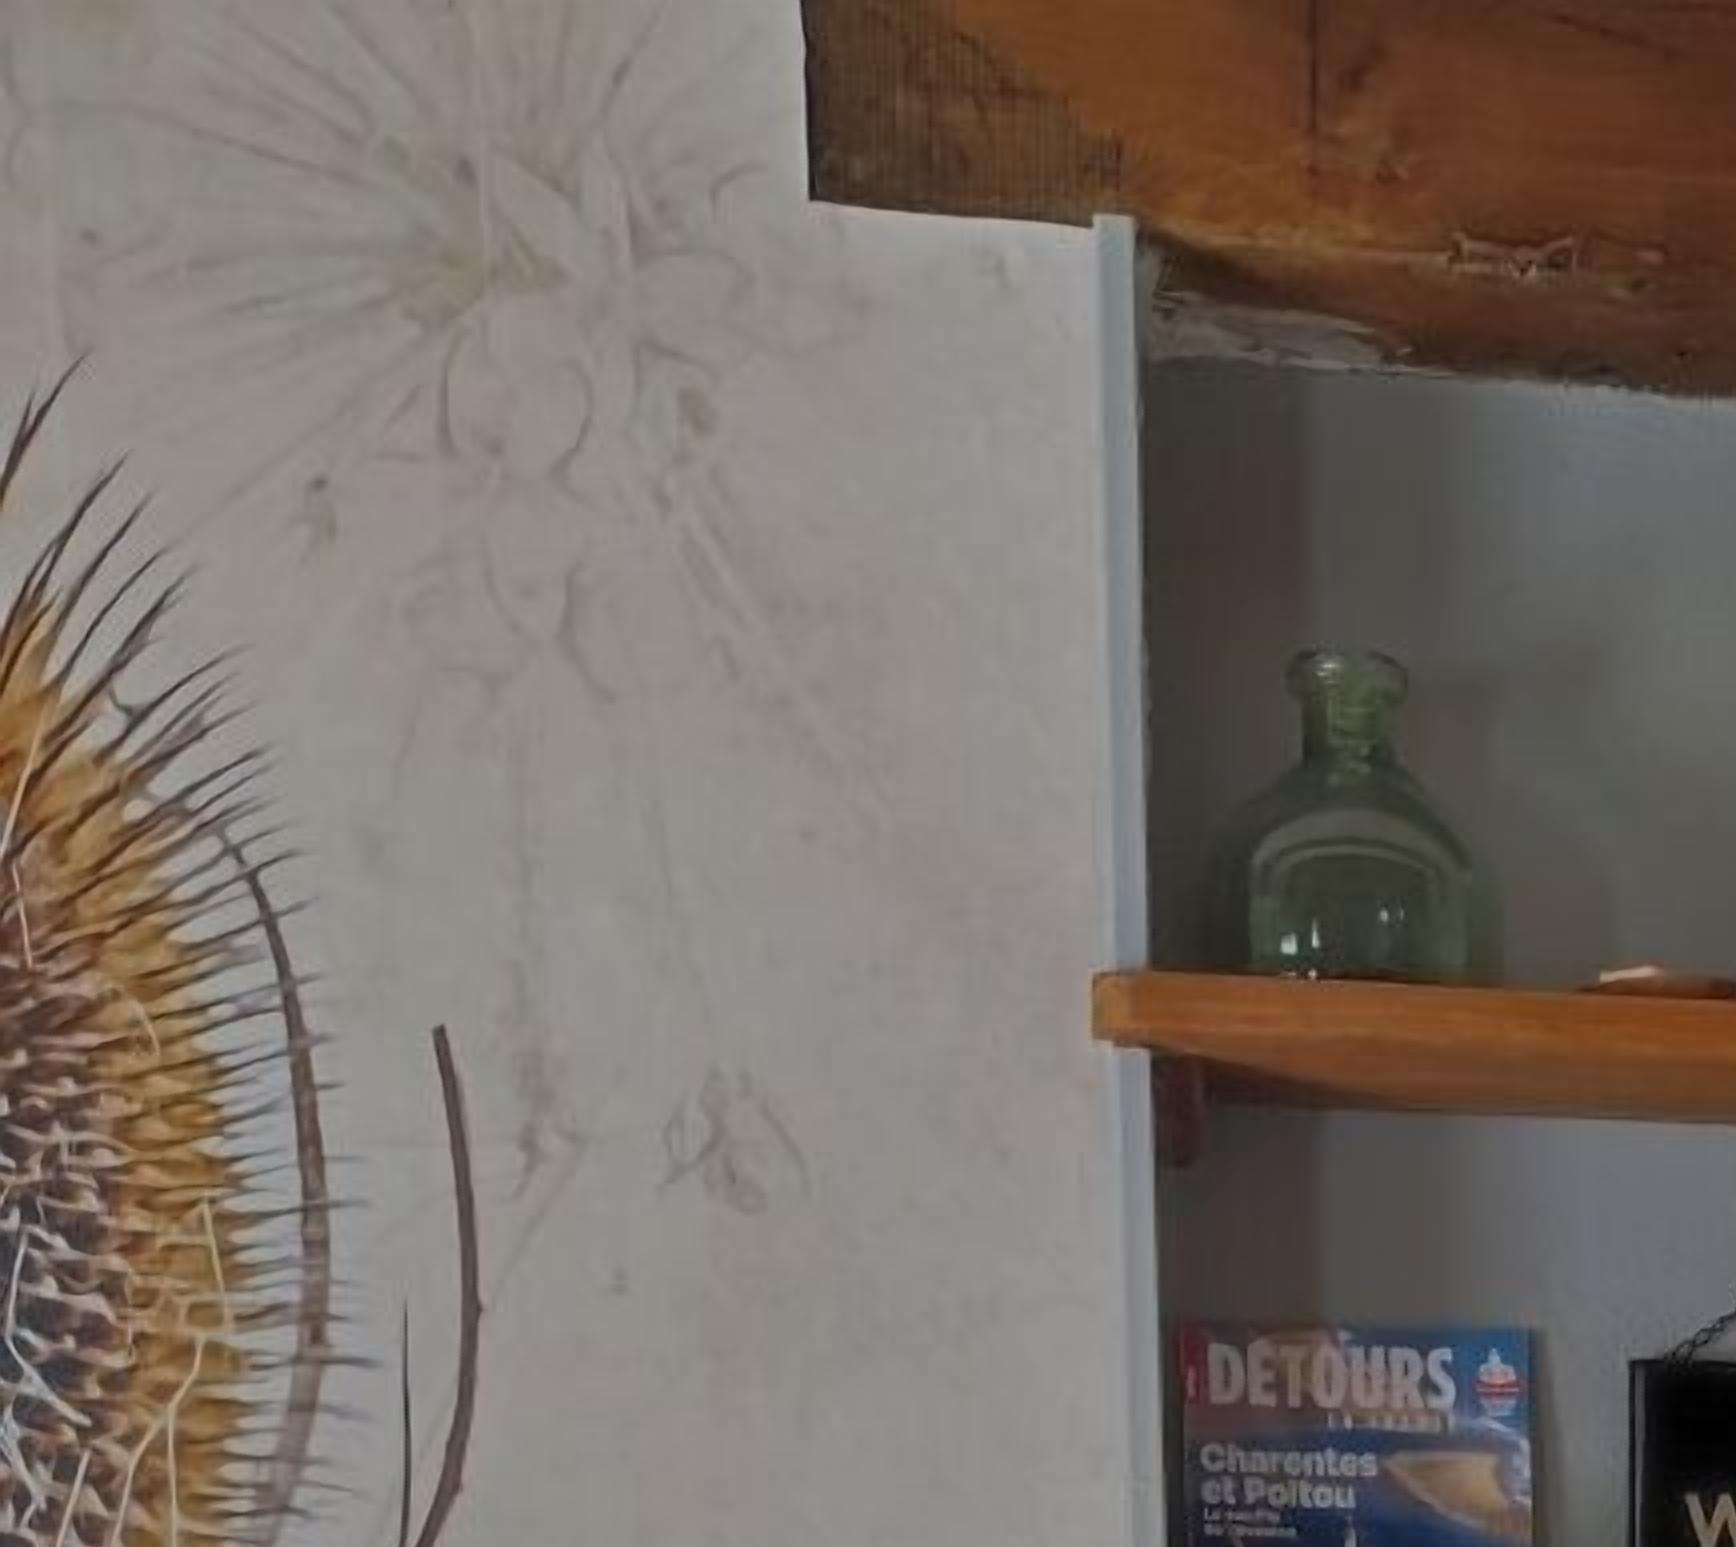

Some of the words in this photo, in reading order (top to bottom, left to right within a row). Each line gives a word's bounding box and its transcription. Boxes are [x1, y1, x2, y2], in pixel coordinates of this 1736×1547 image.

[1200, 1443, 1378, 1477] Charentes
[1201, 1477, 1237, 1505] et
[1243, 1476, 1356, 1509] Poitou
